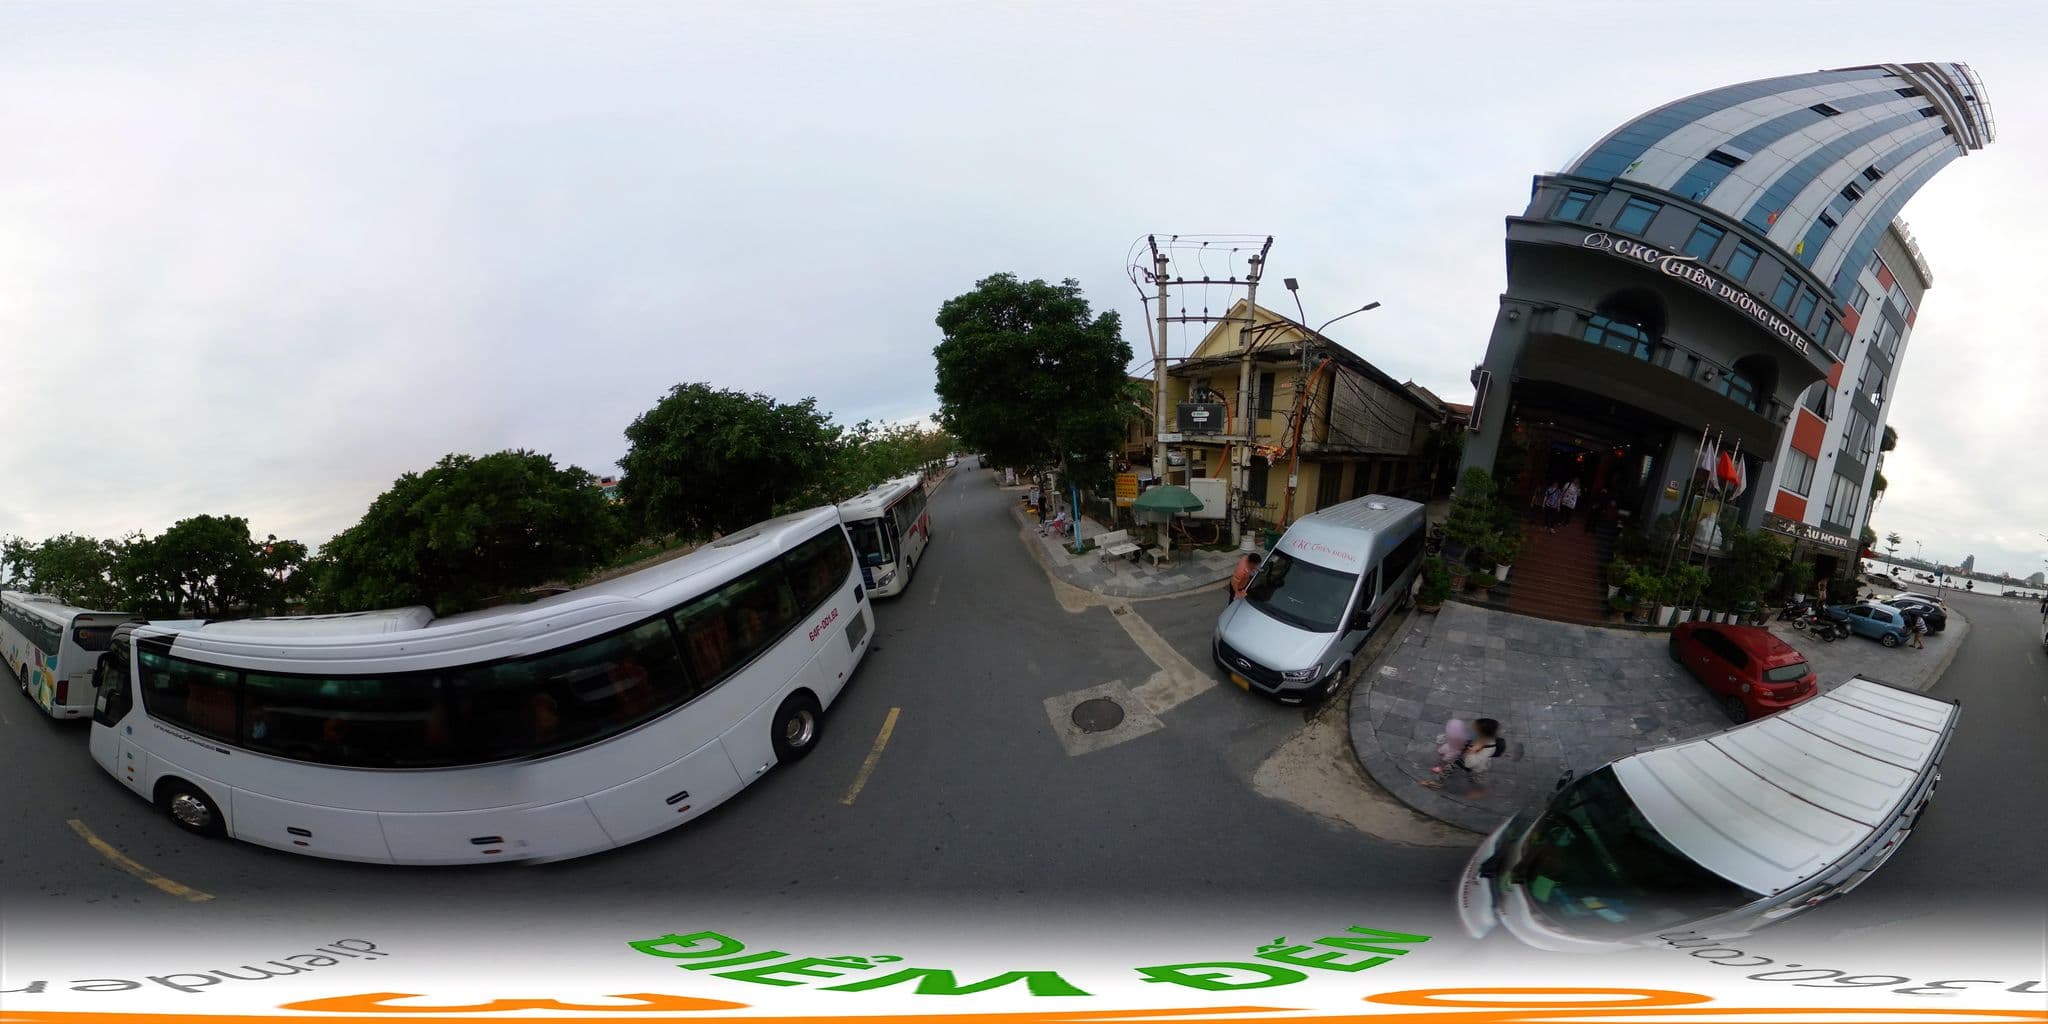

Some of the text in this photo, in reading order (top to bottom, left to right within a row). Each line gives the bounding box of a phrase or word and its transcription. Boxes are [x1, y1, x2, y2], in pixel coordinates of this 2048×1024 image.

[1614, 240, 1659, 263] CKC
[1656, 255, 1717, 290] THIÊN
[1768, 316, 1809, 356] HOTEL
[1820, 532, 1848, 547] HOTEL
